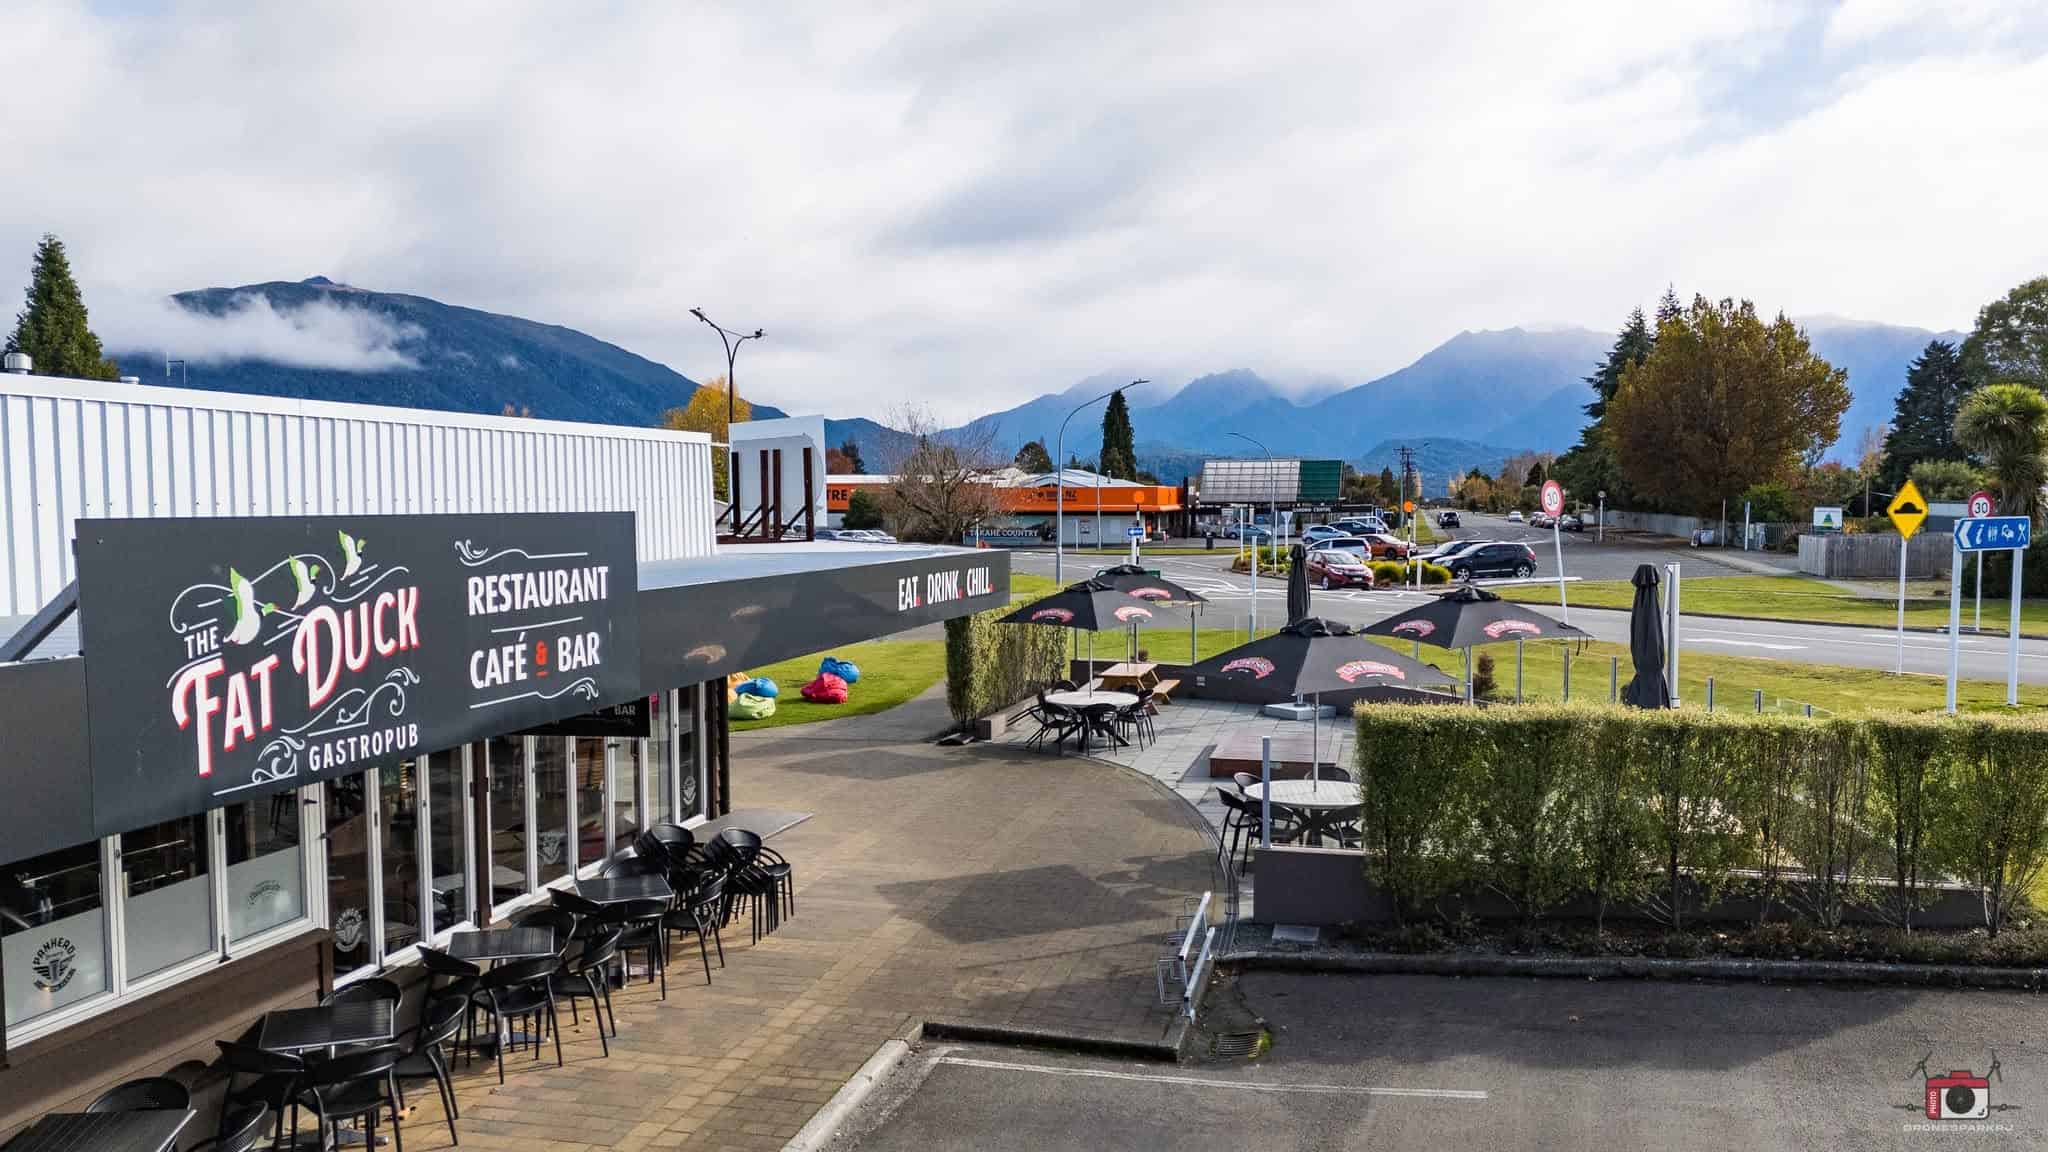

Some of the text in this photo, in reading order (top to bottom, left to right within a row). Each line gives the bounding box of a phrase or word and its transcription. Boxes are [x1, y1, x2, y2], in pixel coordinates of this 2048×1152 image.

[1547, 491, 1558, 506] 30
[1975, 502, 1988, 514] 30
[1002, 529, 1039, 537] COUNTRY
[468, 566, 608, 616] RESTAURANT
[898, 567, 994, 611] EAT. DRINK. CHILL.
[184, 626, 219, 659] THE
[470, 632, 528, 689] CAFÉ
[557, 632, 601, 672] BAR
[172, 586, 420, 778] FAT DUCK
[614, 705, 636, 716] BAR
[309, 723, 418, 771] GASTROPUB
